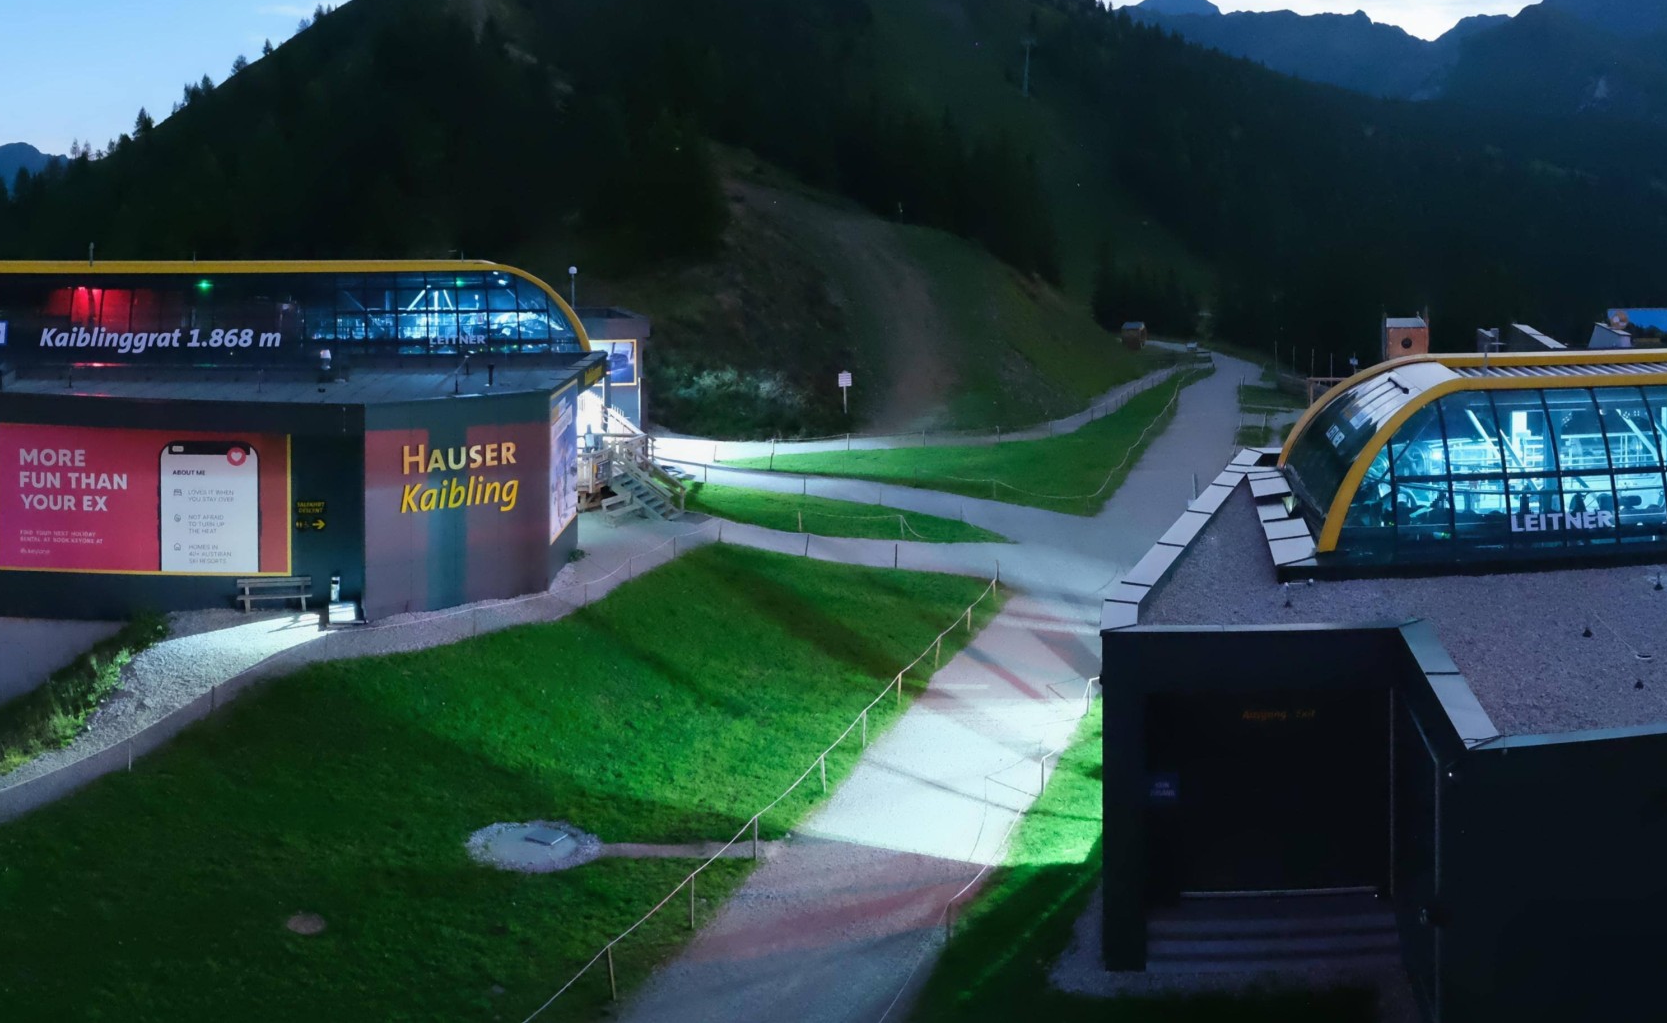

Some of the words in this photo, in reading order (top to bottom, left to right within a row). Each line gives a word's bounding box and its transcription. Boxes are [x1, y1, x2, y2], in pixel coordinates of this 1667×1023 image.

[39, 327, 181, 353] Kaiblinggrat
[187, 328, 254, 347] 1.868
[259, 331, 282, 347] m
[429, 334, 486, 345] LEITNER
[20, 448, 86, 467] MORE
[402, 441, 517, 475] HAUSER
[20, 471, 61, 489] FUN
[67, 472, 128, 490] THAN
[20, 494, 76, 511] YOUR
[83, 495, 108, 511] EX
[401, 476, 519, 514] Kaibling
[1511, 510, 1613, 533] LEITNER
